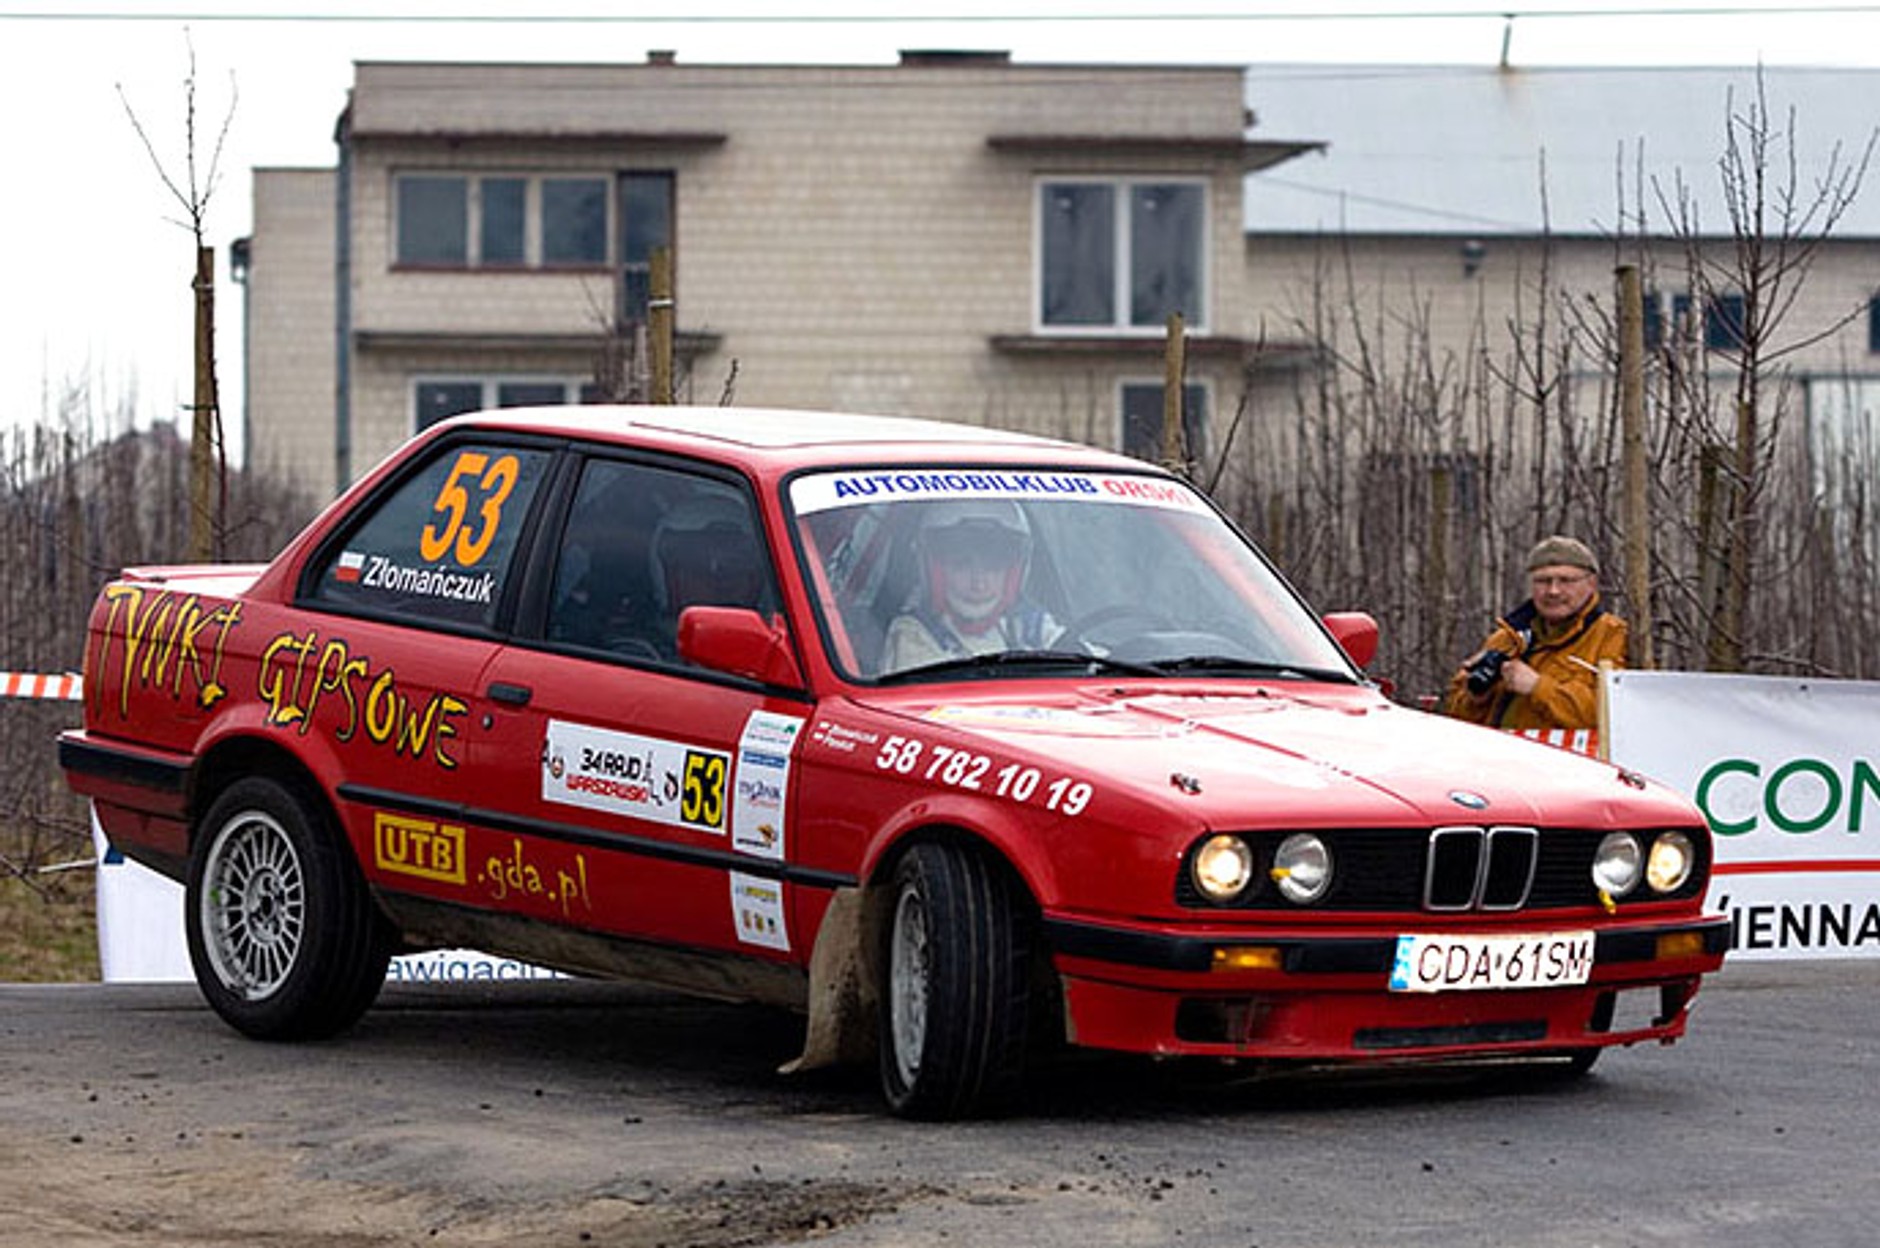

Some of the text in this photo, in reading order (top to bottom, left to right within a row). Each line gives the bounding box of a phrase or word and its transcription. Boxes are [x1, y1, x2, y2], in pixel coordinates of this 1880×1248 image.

[420, 453, 520, 566] 53
[833, 474, 1099, 498] AUTOMOBILKLUB
[363, 556, 495, 602] Złomańczuk
[94, 585, 468, 767] TYNKI GIPSOWE
[682, 754, 725, 827] 53
[876, 736, 922, 774] 58
[925, 745, 991, 790] 782
[996, 764, 1041, 801] 10
[1046, 777, 1093, 816] 19
[386, 827, 591, 917] UTB .gda.pl
[1719, 895, 1880, 949] IENNA
